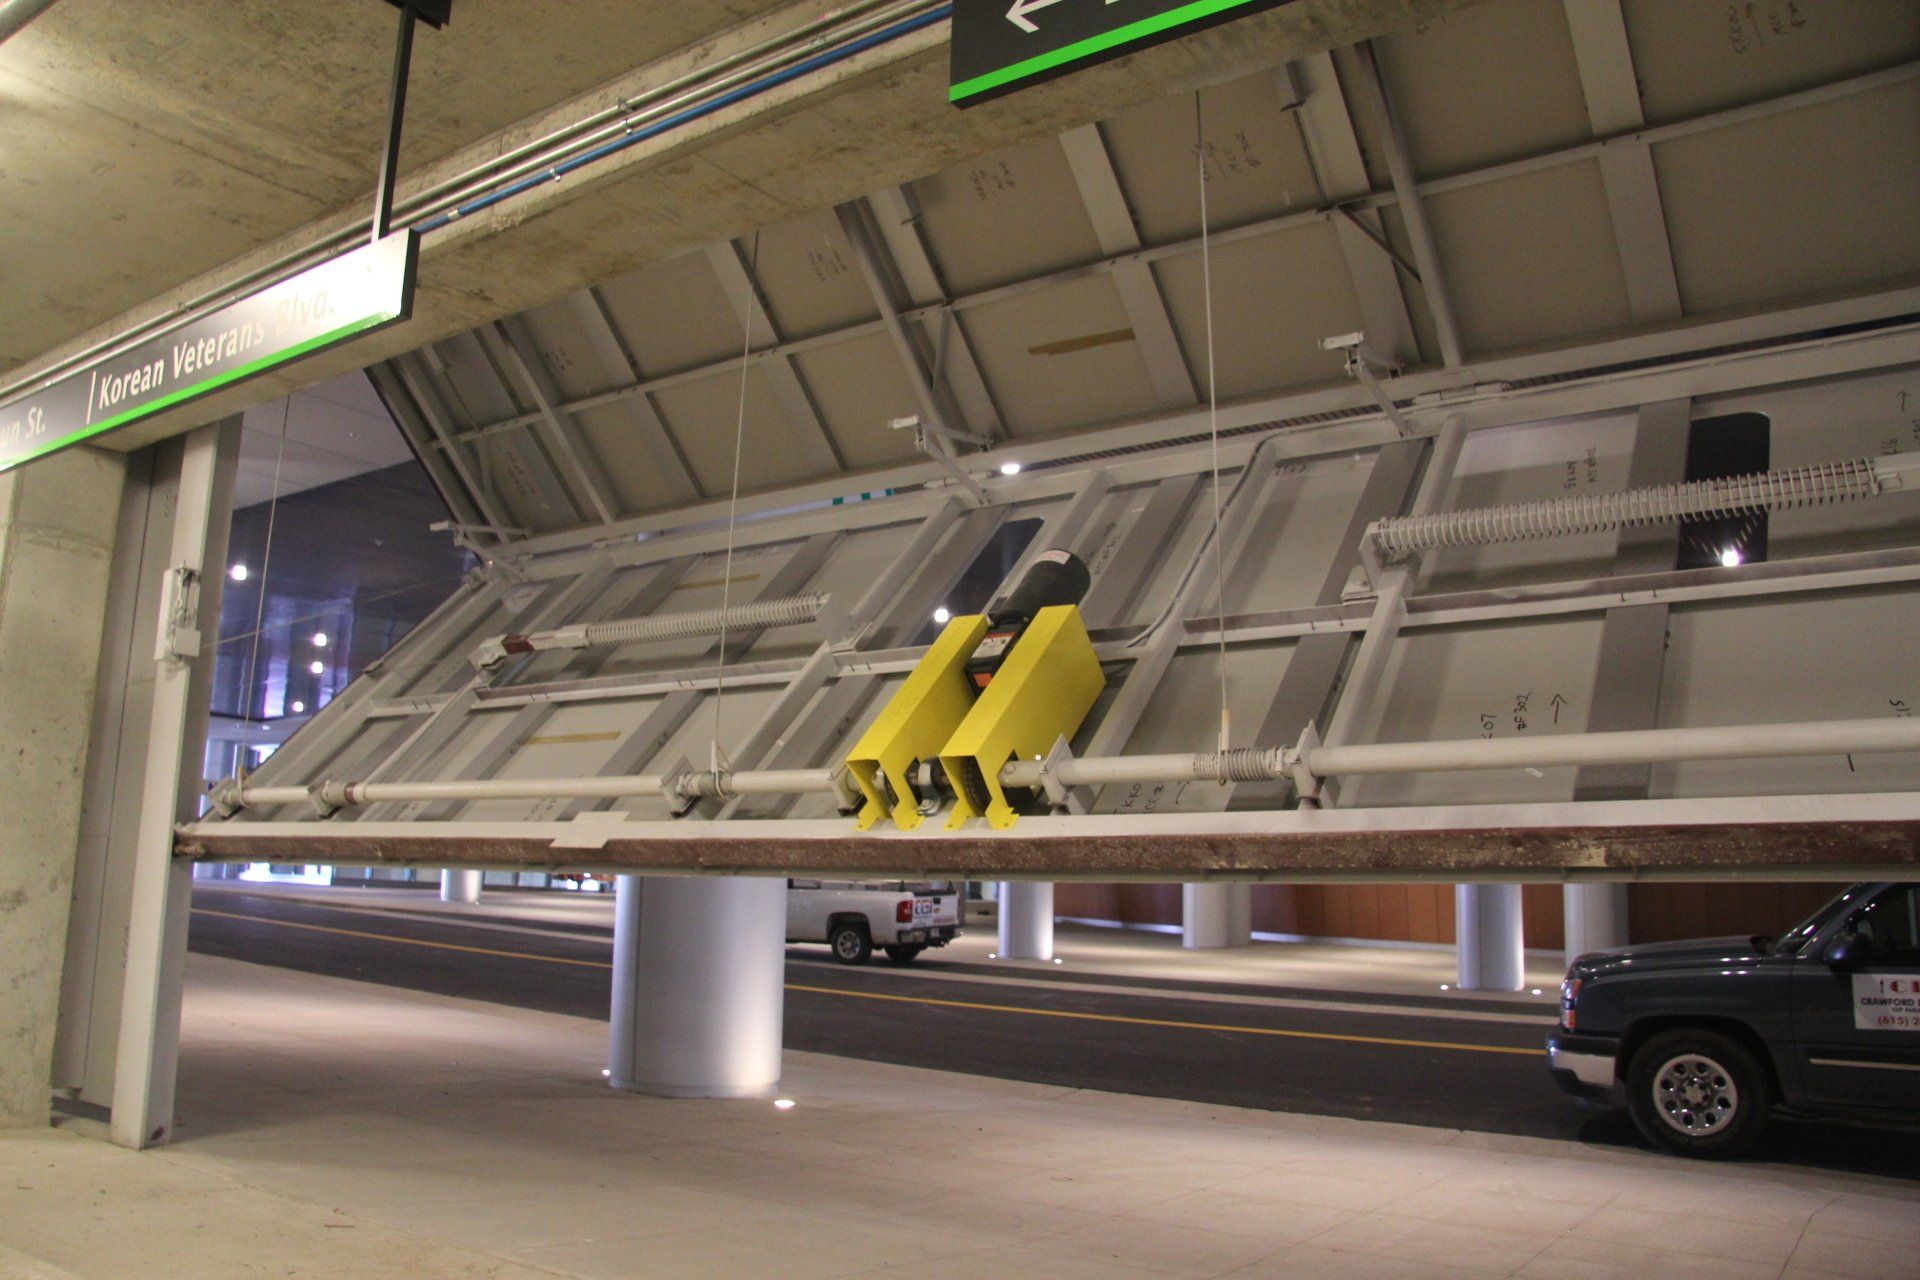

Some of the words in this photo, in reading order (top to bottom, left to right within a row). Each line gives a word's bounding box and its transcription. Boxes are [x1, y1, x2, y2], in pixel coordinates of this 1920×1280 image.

[99, 360, 165, 410] Korean
[173, 319, 265, 379] Veterans
[274, 283, 334, 337] Blvd.
[25, 406, 46, 438] St.
[1861, 997, 1915, 1006] CRAWFORD
[1878, 1016, 1909, 1027] (615)
